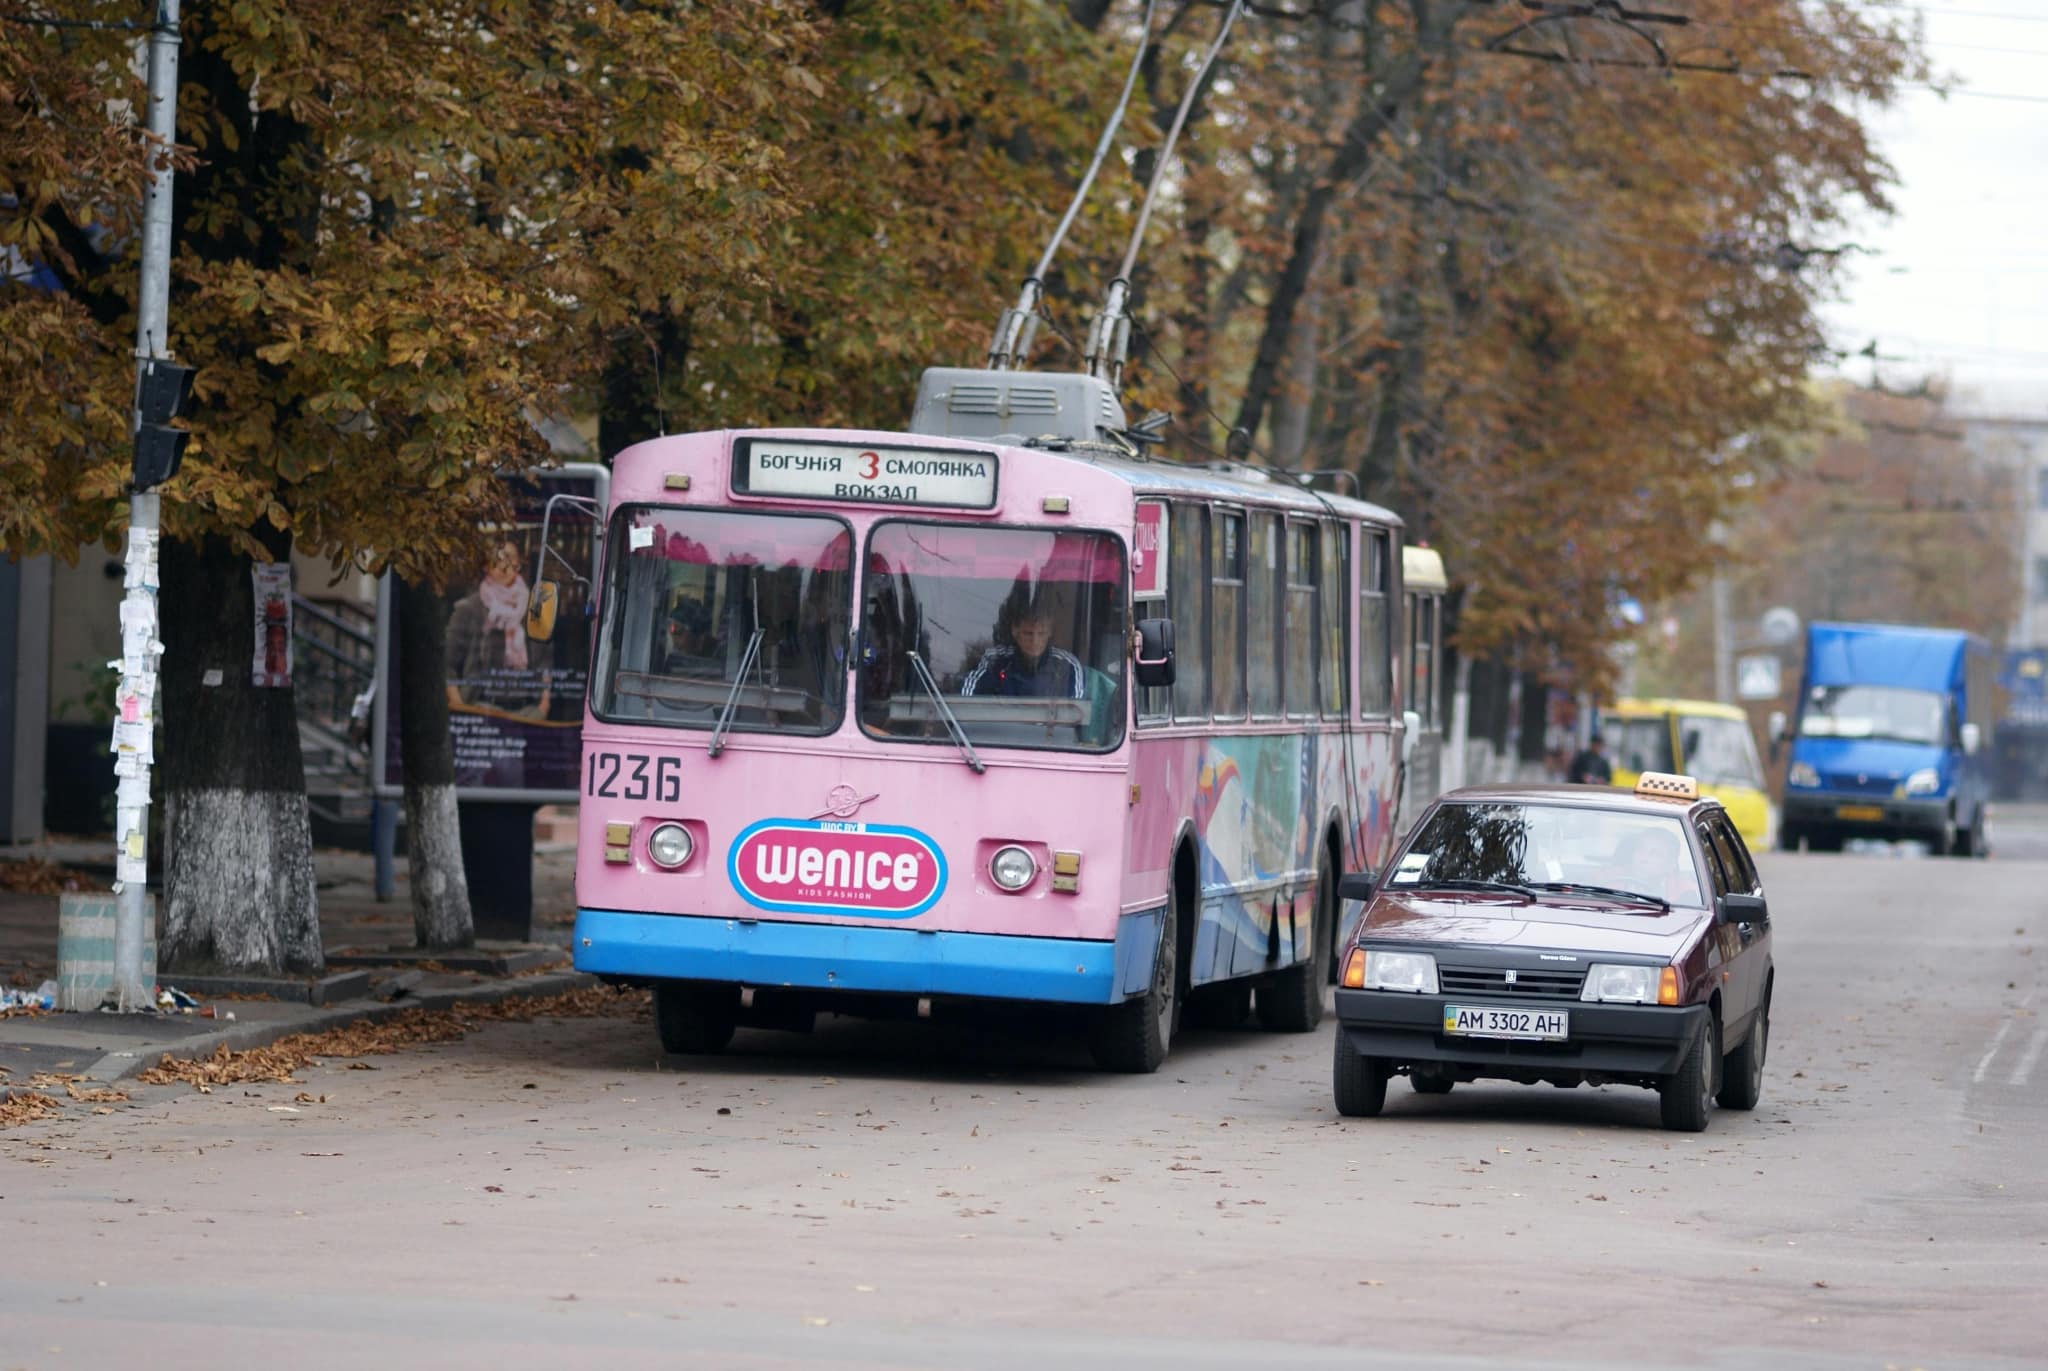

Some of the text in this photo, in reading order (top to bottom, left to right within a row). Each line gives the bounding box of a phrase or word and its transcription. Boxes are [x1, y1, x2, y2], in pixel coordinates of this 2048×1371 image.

[858, 451, 881, 480] 3
[885, 459, 986, 478] СМОЛЯНКА
[834, 483, 918, 501] ВОКЗАЛ
[587, 752, 682, 802] 1236
[798, 888, 872, 900] KIDS FASHION
[1489, 1012, 1530, 1032] 3302
